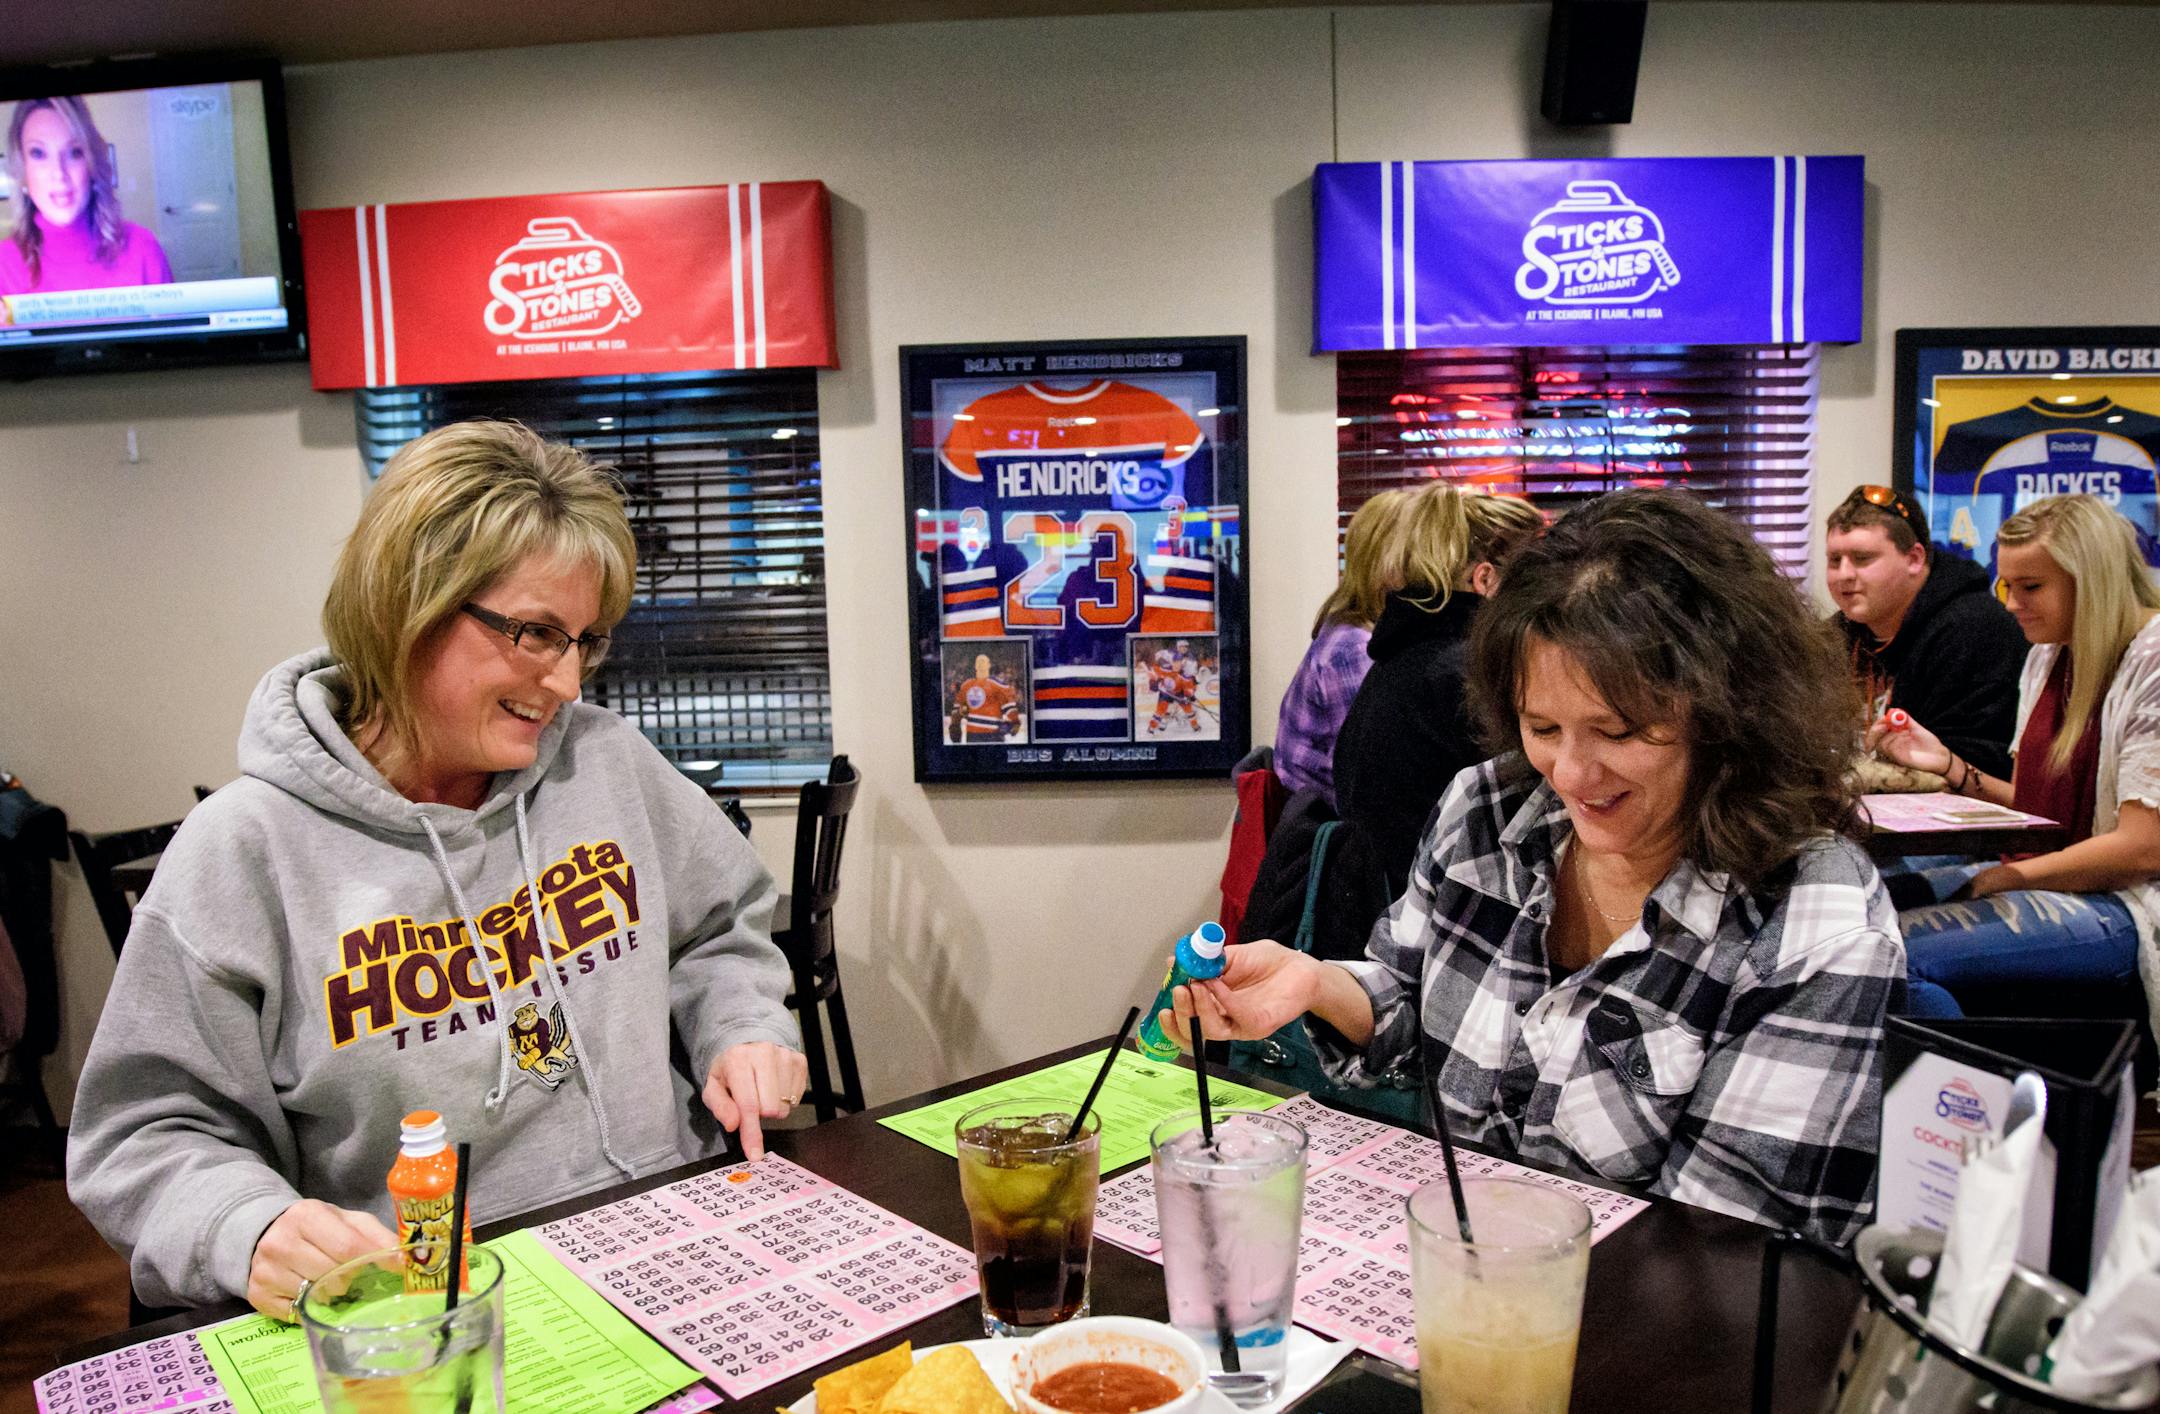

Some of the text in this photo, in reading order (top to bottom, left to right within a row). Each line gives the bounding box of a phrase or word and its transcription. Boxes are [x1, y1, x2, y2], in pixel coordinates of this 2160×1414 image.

[1515, 250, 1651, 299] STONES
[1564, 276, 1639, 298] RESTAURANT
[484, 285, 612, 335] STONES
[1526, 310, 1536, 320] AT
[1538, 310, 1553, 320] THE
[531, 309, 600, 332] RESTAURANT
[964, 352, 1183, 373] MATT HENDRICKS
[1961, 349, 2060, 371] DAVID
[997, 460, 1141, 499] HENDRICKS
[2016, 471, 2122, 508] BACKES
[1004, 511, 1139, 630] 23
[1007, 747, 1158, 763] BHS ALUMNI
[339, 839, 626, 971] Minnesota
[323, 863, 641, 1051] HOCKEY
[391, 930, 640, 1051] TEAM ISSUE
[885, 1240, 907, 1251] 20
[898, 1247, 921, 1259] 28
[603, 1235, 722, 1281] 13 28 39 55 67
[688, 1250, 711, 1260] 29
[861, 1250, 884, 1261] 38
[665, 1259, 684, 1268] 41
[700, 1259, 721, 1268] 18
[838, 1259, 861, 1270] 59
[875, 1258, 896, 1269] 43
[637, 1267, 661, 1280] 50
[815, 1269, 838, 1280] 74
[842, 1248, 956, 1296] 12 18 57 63
[852, 1267, 876, 1278] 58
[857, 1256, 969, 1304] 5 24 36 60 69
[611, 1278, 635, 1289] 70
[633, 1258, 756, 1307] 5 21 38 60 69
[648, 1275, 672, 1288] 58
[830, 1276, 851, 1288] 61
[621, 1286, 646, 1298] 73
[644, 1266, 771, 1316] 11 22 34 54 63
[871, 1271, 966, 1313] 30 39 50 65
[1316, 1287, 1340, 1298] 67
[1341, 1296, 1364, 1306] 49
[671, 1284, 797, 1335] 9 21 35 50 63
[1300, 1294, 1402, 1338] 30 34 54 73
[1366, 1306, 1390, 1318] 45
[684, 1292, 813, 1345] 12 23 39 60 73
[697, 1300, 828, 1356] 10 22 46 65
[146, 1339, 172, 1351] 25
[711, 1309, 842, 1366] 15 25 41 47 64
[115, 1348, 138, 1361] 31
[725, 1318, 854, 1376] 2 29 44 52 74
[149, 1350, 176, 1362] 23
[80, 1358, 104, 1372] 51
[116, 1358, 142, 1371] 33
[44, 1370, 70, 1387] 64
[80, 1368, 106, 1383] 49
[46, 1380, 73, 1397] 63
